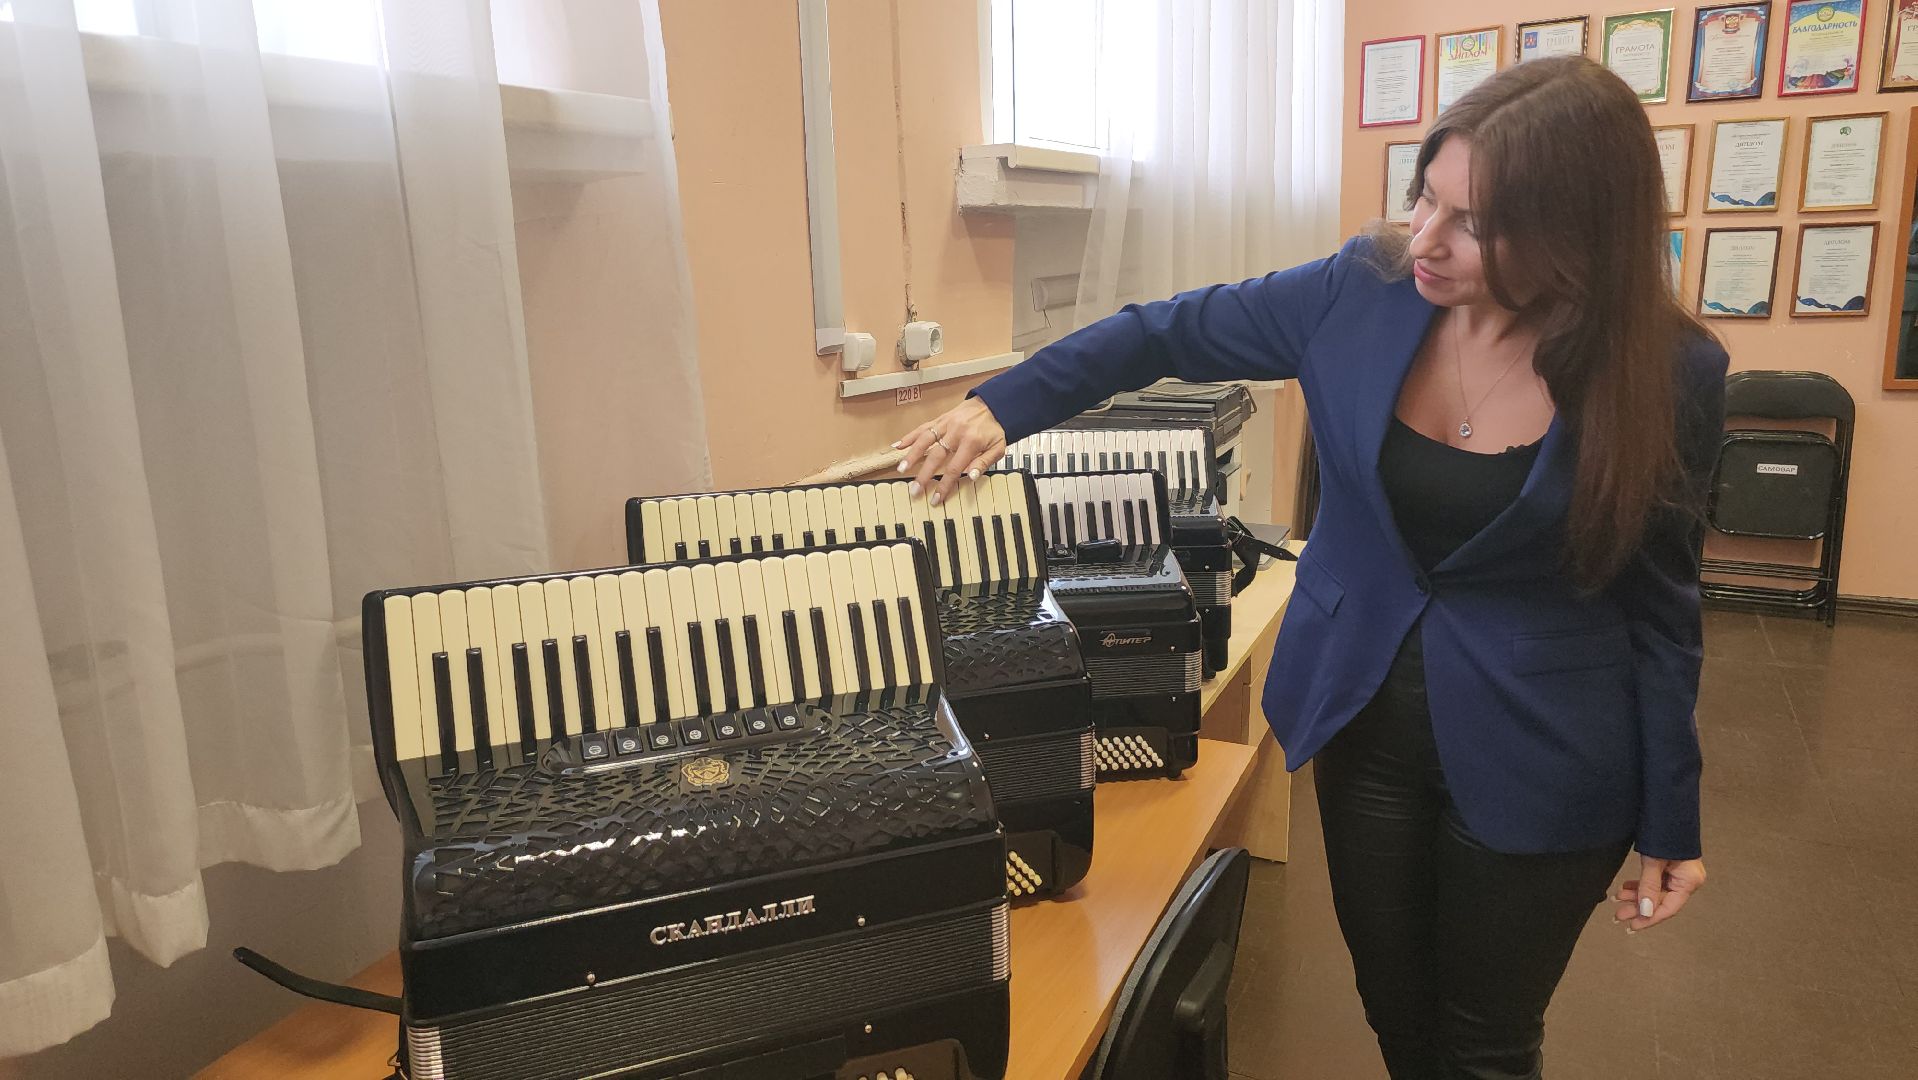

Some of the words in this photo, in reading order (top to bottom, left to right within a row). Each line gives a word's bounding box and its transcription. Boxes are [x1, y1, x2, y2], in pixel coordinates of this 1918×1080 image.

[1615, 43, 1655, 54] ГРАМОТА
[899, 388, 912, 402] 220
[650, 895, 815, 945] СКАНДАЛЛИ
